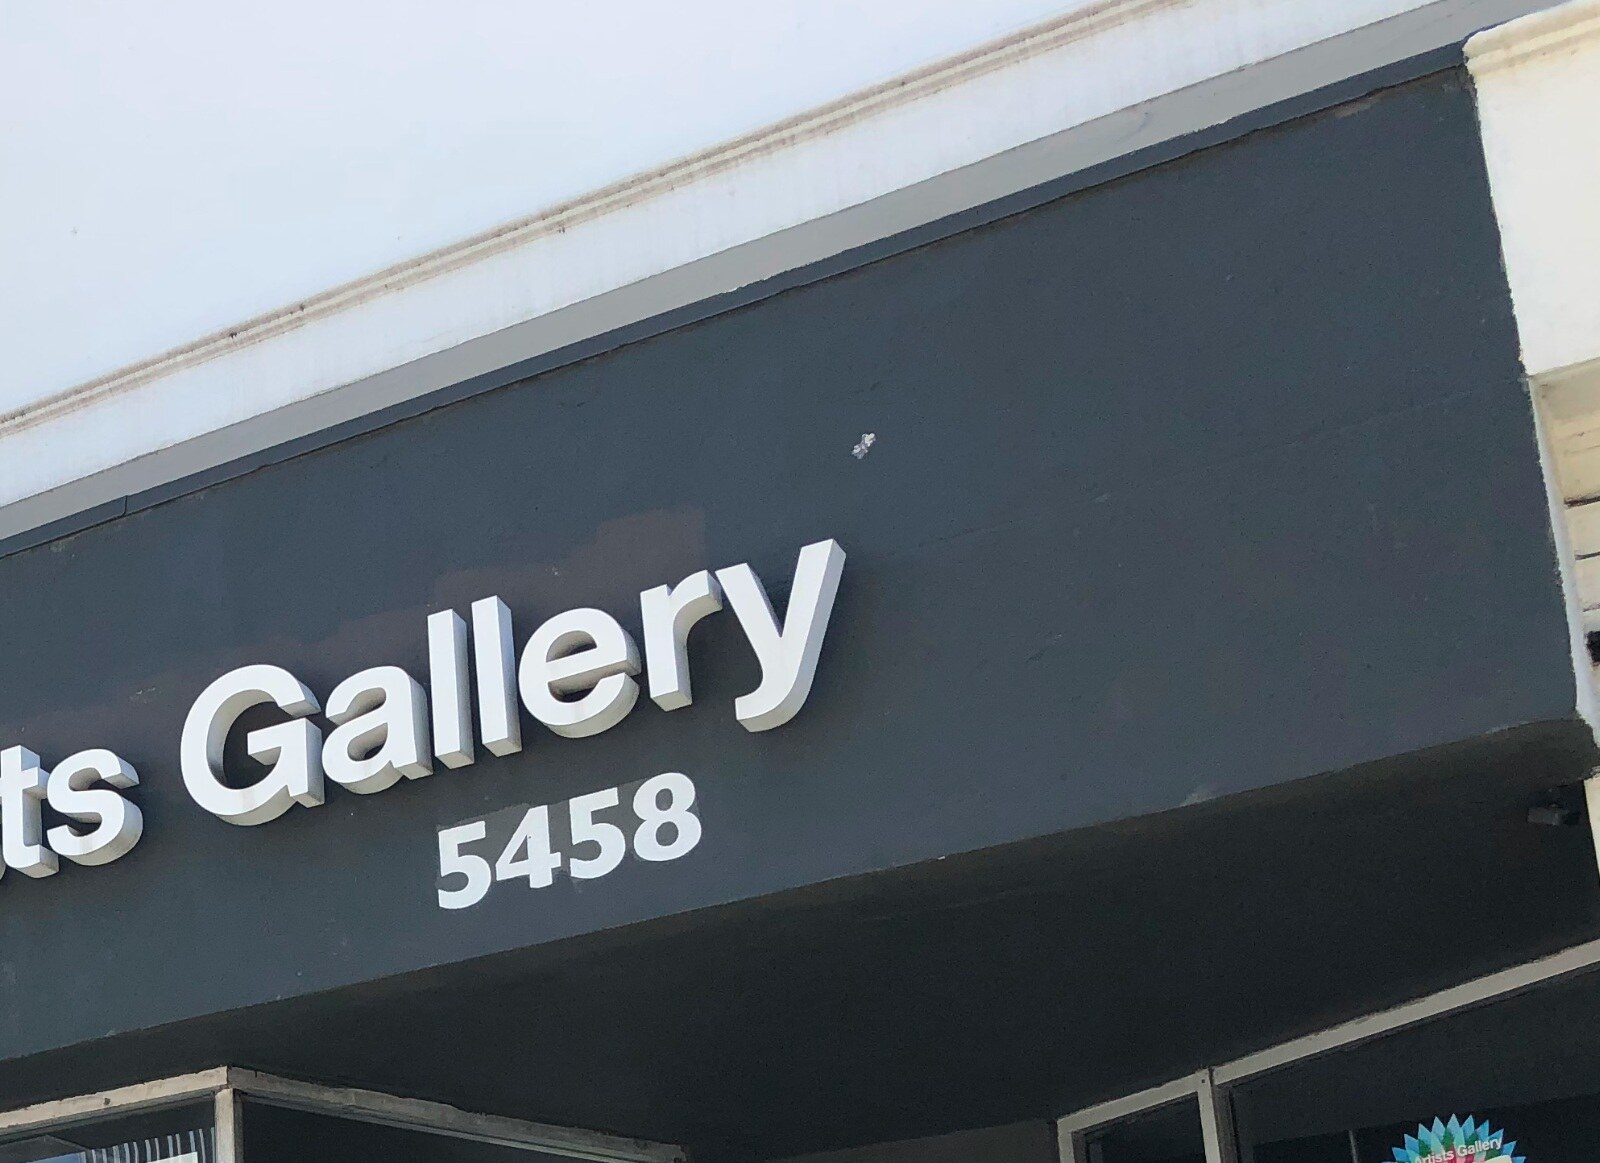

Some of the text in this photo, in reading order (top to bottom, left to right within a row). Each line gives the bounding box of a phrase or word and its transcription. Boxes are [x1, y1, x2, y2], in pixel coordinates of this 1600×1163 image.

[180, 538, 846, 826] Gallery
[438, 772, 703, 909] 5458
[1457, 1136, 1503, 1156] Gallery
